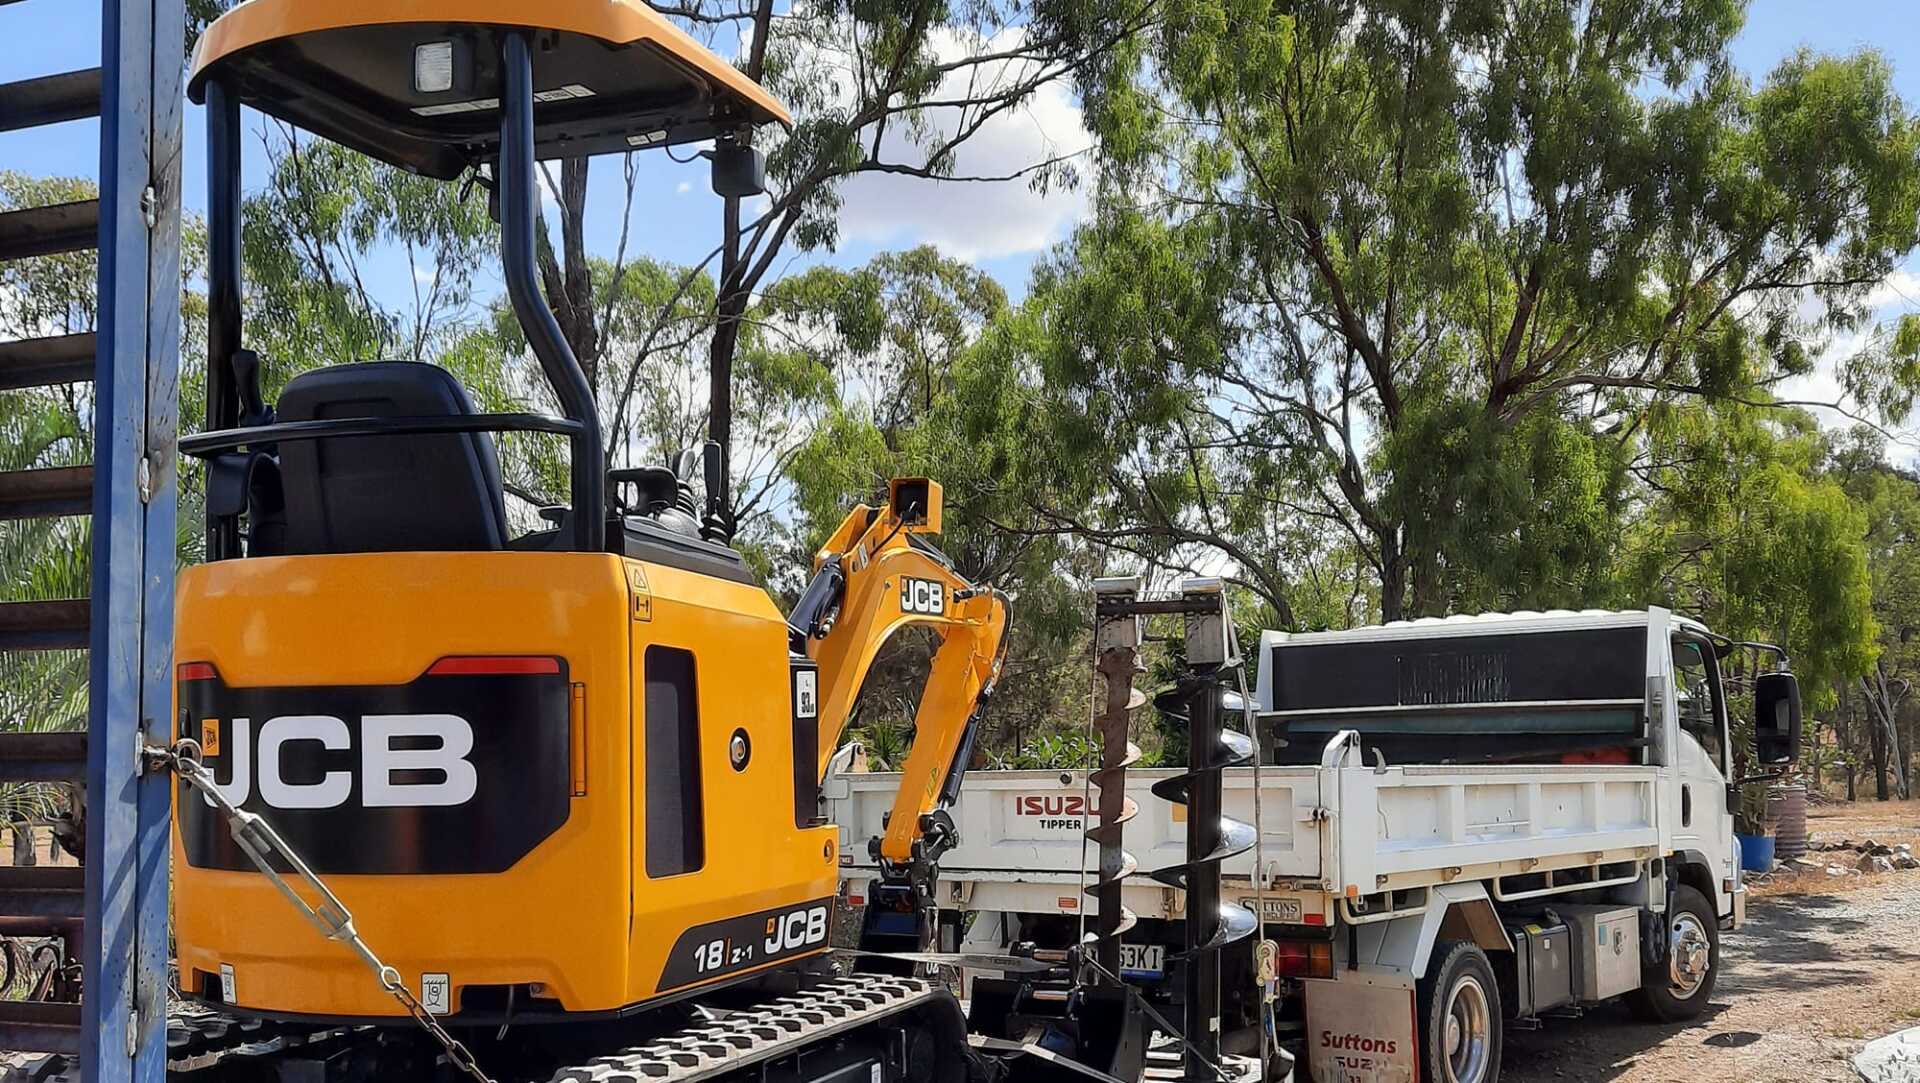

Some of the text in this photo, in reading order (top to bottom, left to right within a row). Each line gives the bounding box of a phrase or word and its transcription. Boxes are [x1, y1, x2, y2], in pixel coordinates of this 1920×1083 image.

[901, 579, 943, 613] JCB
[201, 714, 478, 809] JCB
[1039, 819, 1082, 830] TIPPER
[764, 906, 827, 955] JCB
[694, 939, 724, 973] 18
[1320, 1030, 1397, 1055] Suttons
